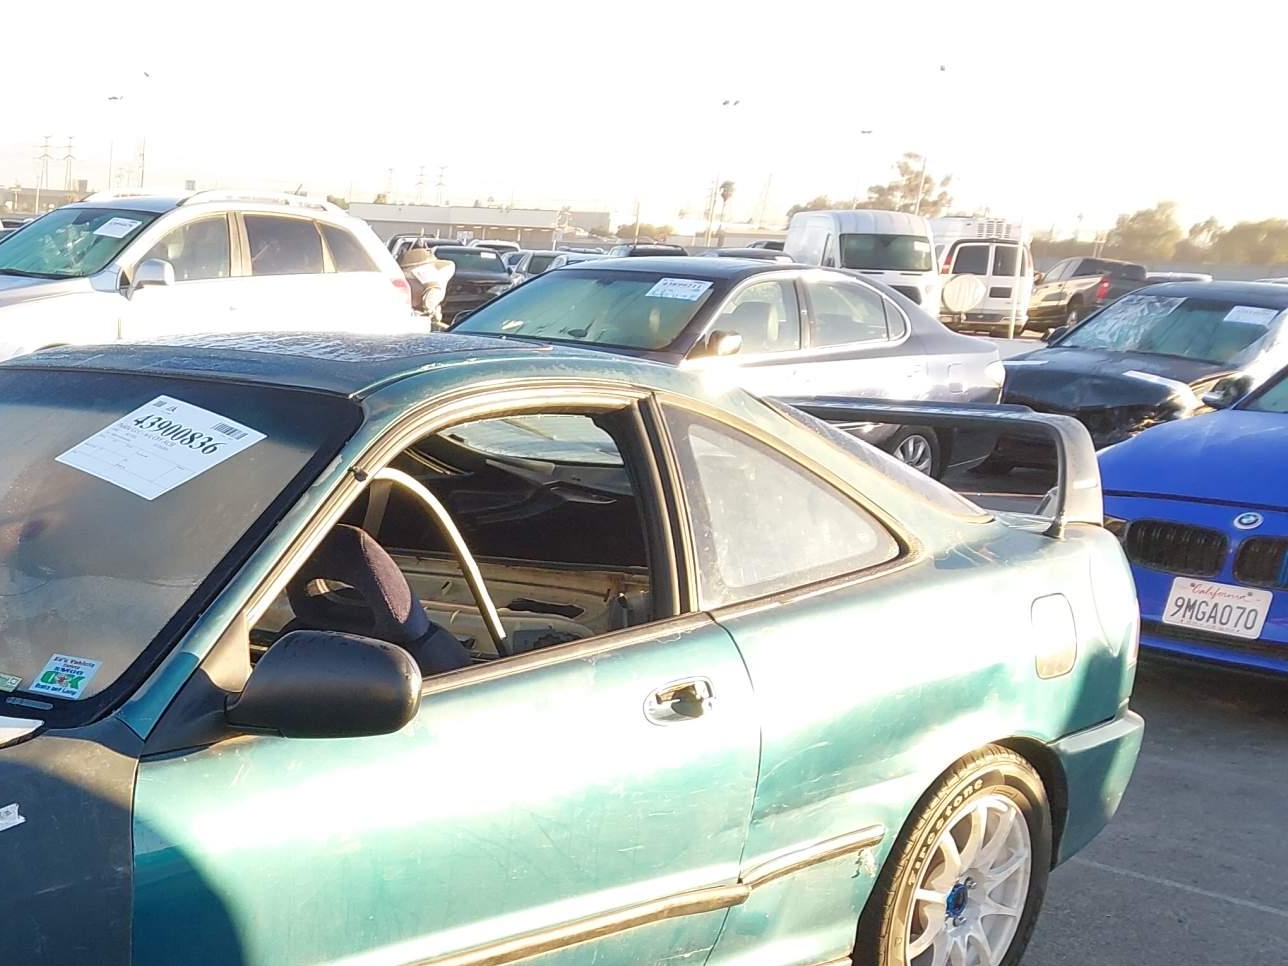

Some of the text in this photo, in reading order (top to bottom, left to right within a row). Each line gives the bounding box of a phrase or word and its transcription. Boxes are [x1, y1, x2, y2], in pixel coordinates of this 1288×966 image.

[133, 414, 226, 456] 43900836
[1190, 582, 1249, 601] California
[1170, 596, 1259, 631] 9MGA070
